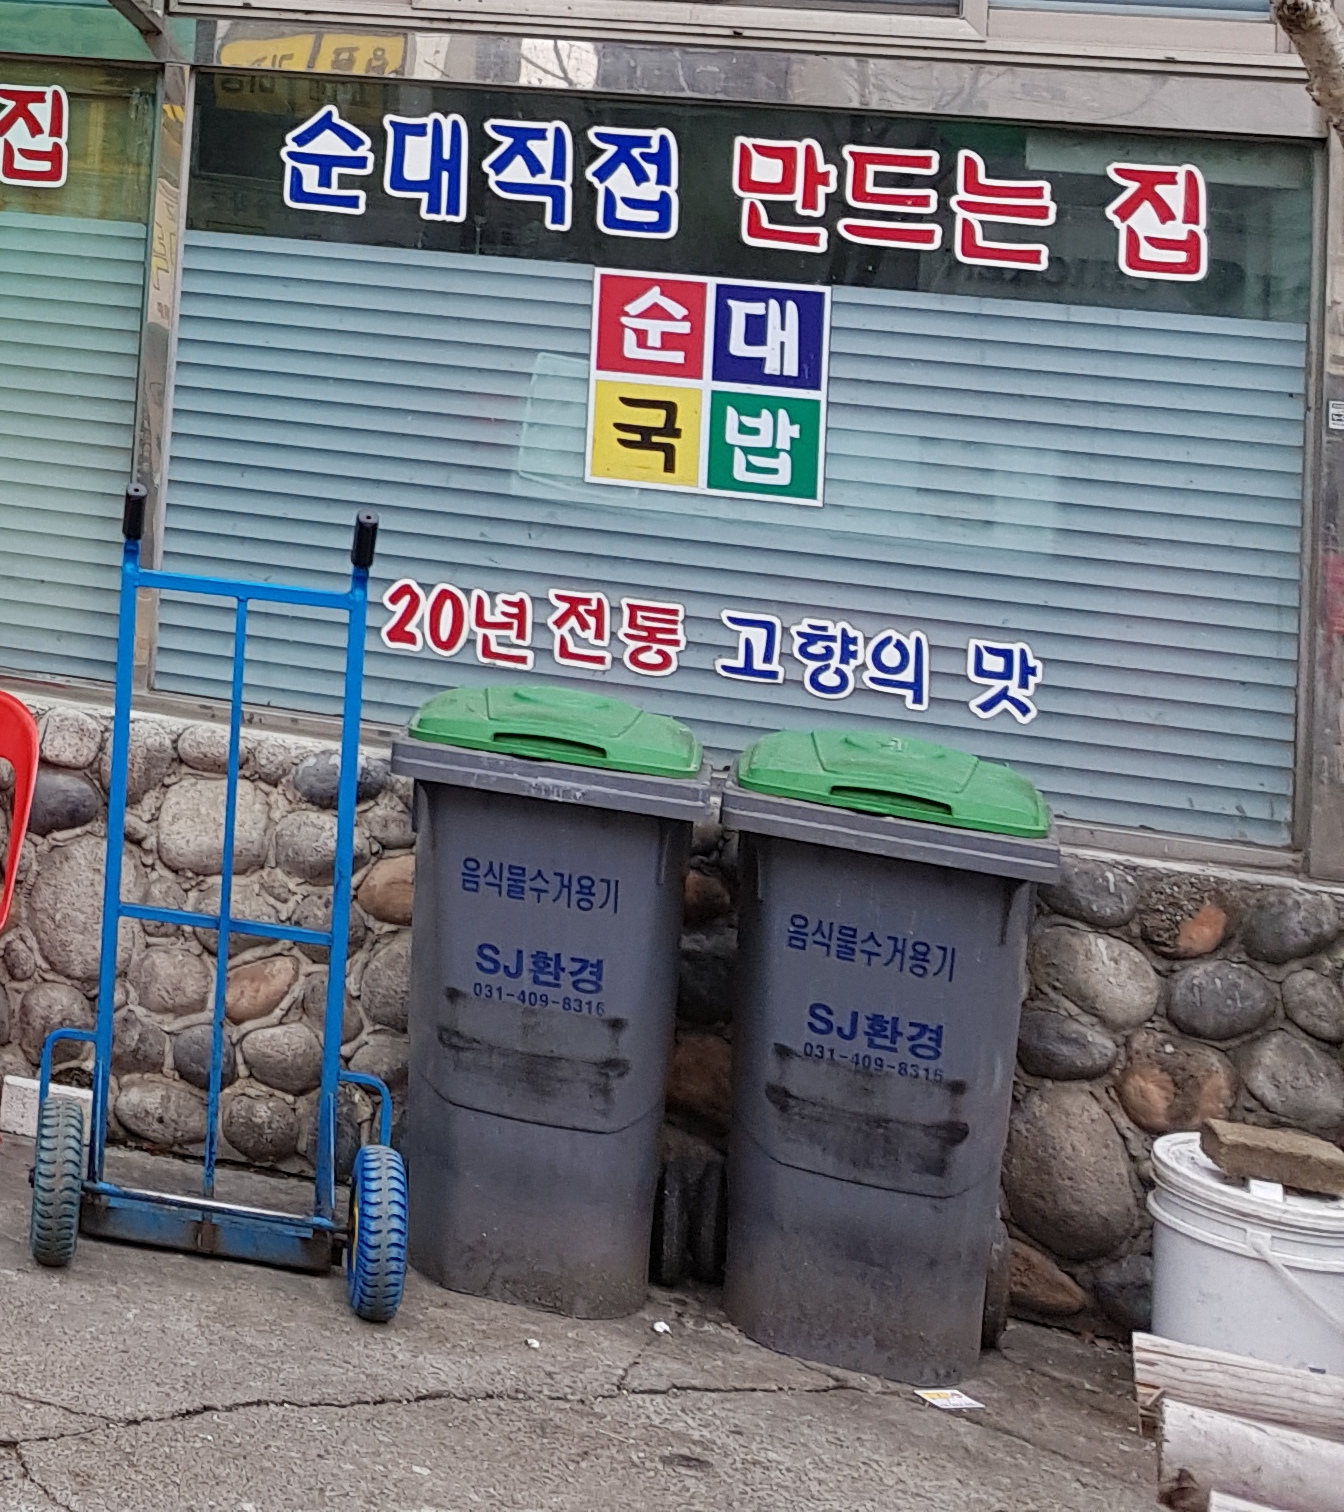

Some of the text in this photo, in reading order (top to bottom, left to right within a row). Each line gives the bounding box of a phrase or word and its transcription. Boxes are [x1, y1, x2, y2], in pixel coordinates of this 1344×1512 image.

[280, 102, 1209, 283] 순대직접 만드는 집
[620, 284, 801, 379] 순대
[614, 396, 802, 488] 국밥
[381, 578, 1043, 725] 20년전통 고향의 맛
[461, 856, 620, 915] 음식물수거용기
[475, 942, 605, 995] SJ환경
[786, 913, 957, 984] 음식물수거용기
[806, 1002, 945, 1062] SJ환경
